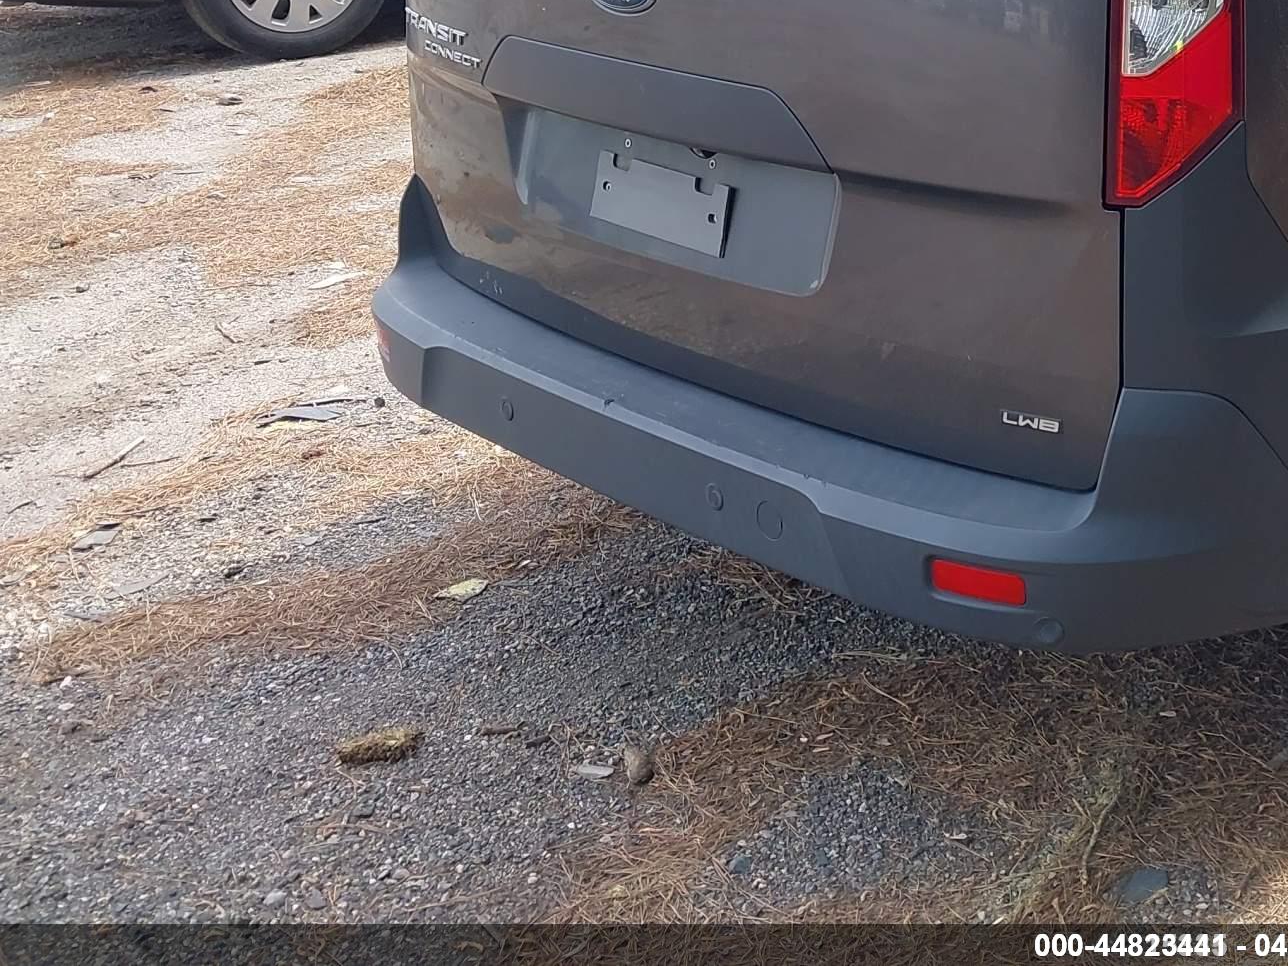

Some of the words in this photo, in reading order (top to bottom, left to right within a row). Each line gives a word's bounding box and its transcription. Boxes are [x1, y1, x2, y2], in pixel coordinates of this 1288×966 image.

[405, 7, 466, 46] TRANSIT
[424, 40, 481, 68] CONNECT
[1002, 411, 1060, 433] LWB
